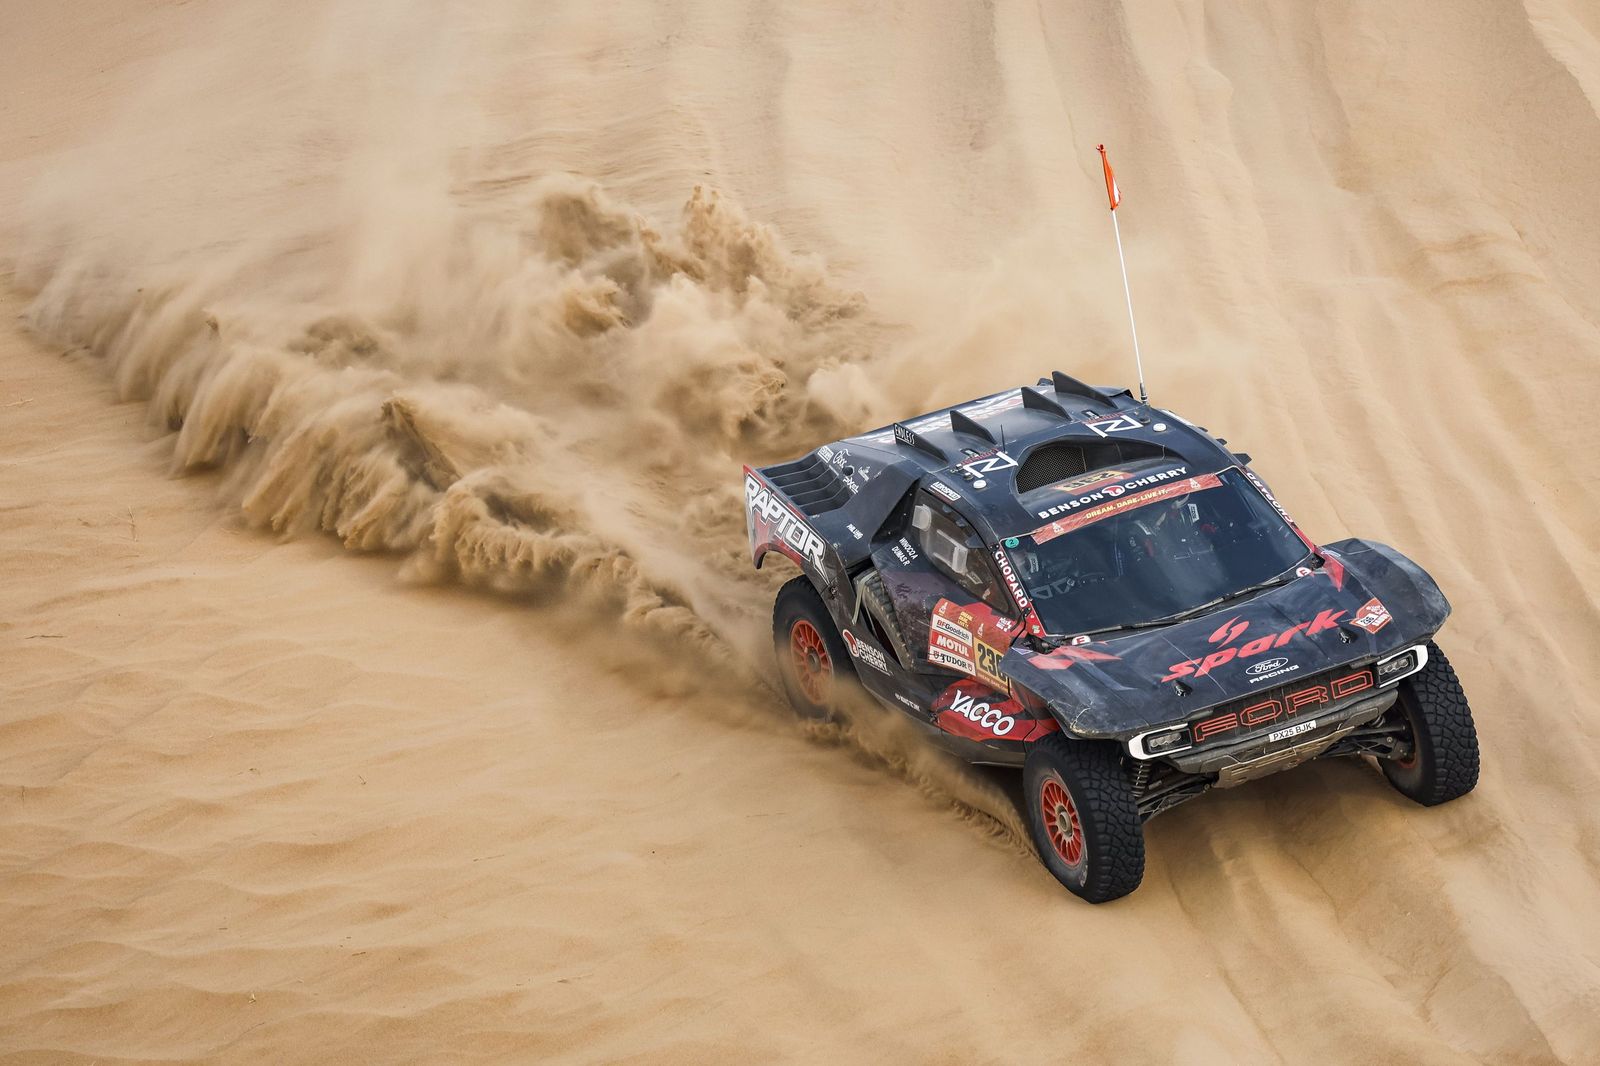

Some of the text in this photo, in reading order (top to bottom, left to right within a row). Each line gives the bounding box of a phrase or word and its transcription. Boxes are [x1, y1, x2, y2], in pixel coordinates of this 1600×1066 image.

[894, 424, 915, 445] ENDLESS
[1037, 492, 1104, 519] BENSON
[1124, 466, 1187, 489] CHERRY
[1246, 472, 1294, 523] CHOPARD
[743, 473, 829, 584] RAPTOR
[994, 549, 1028, 608] CHOPARD
[936, 619, 970, 640] BFGoodrich
[855, 637, 886, 661] BENSON
[936, 634, 970, 657] MOTUL
[1160, 609, 1349, 683] spark
[858, 649, 889, 672] CHERRY
[940, 653, 968, 670] TUDOR
[1254, 660, 1281, 674] Ford
[1249, 664, 1300, 684] RACING
[949, 689, 1015, 736] YACCO
[1194, 670, 1374, 742] FORD
[1273, 722, 1312, 741] PX25 BJK
